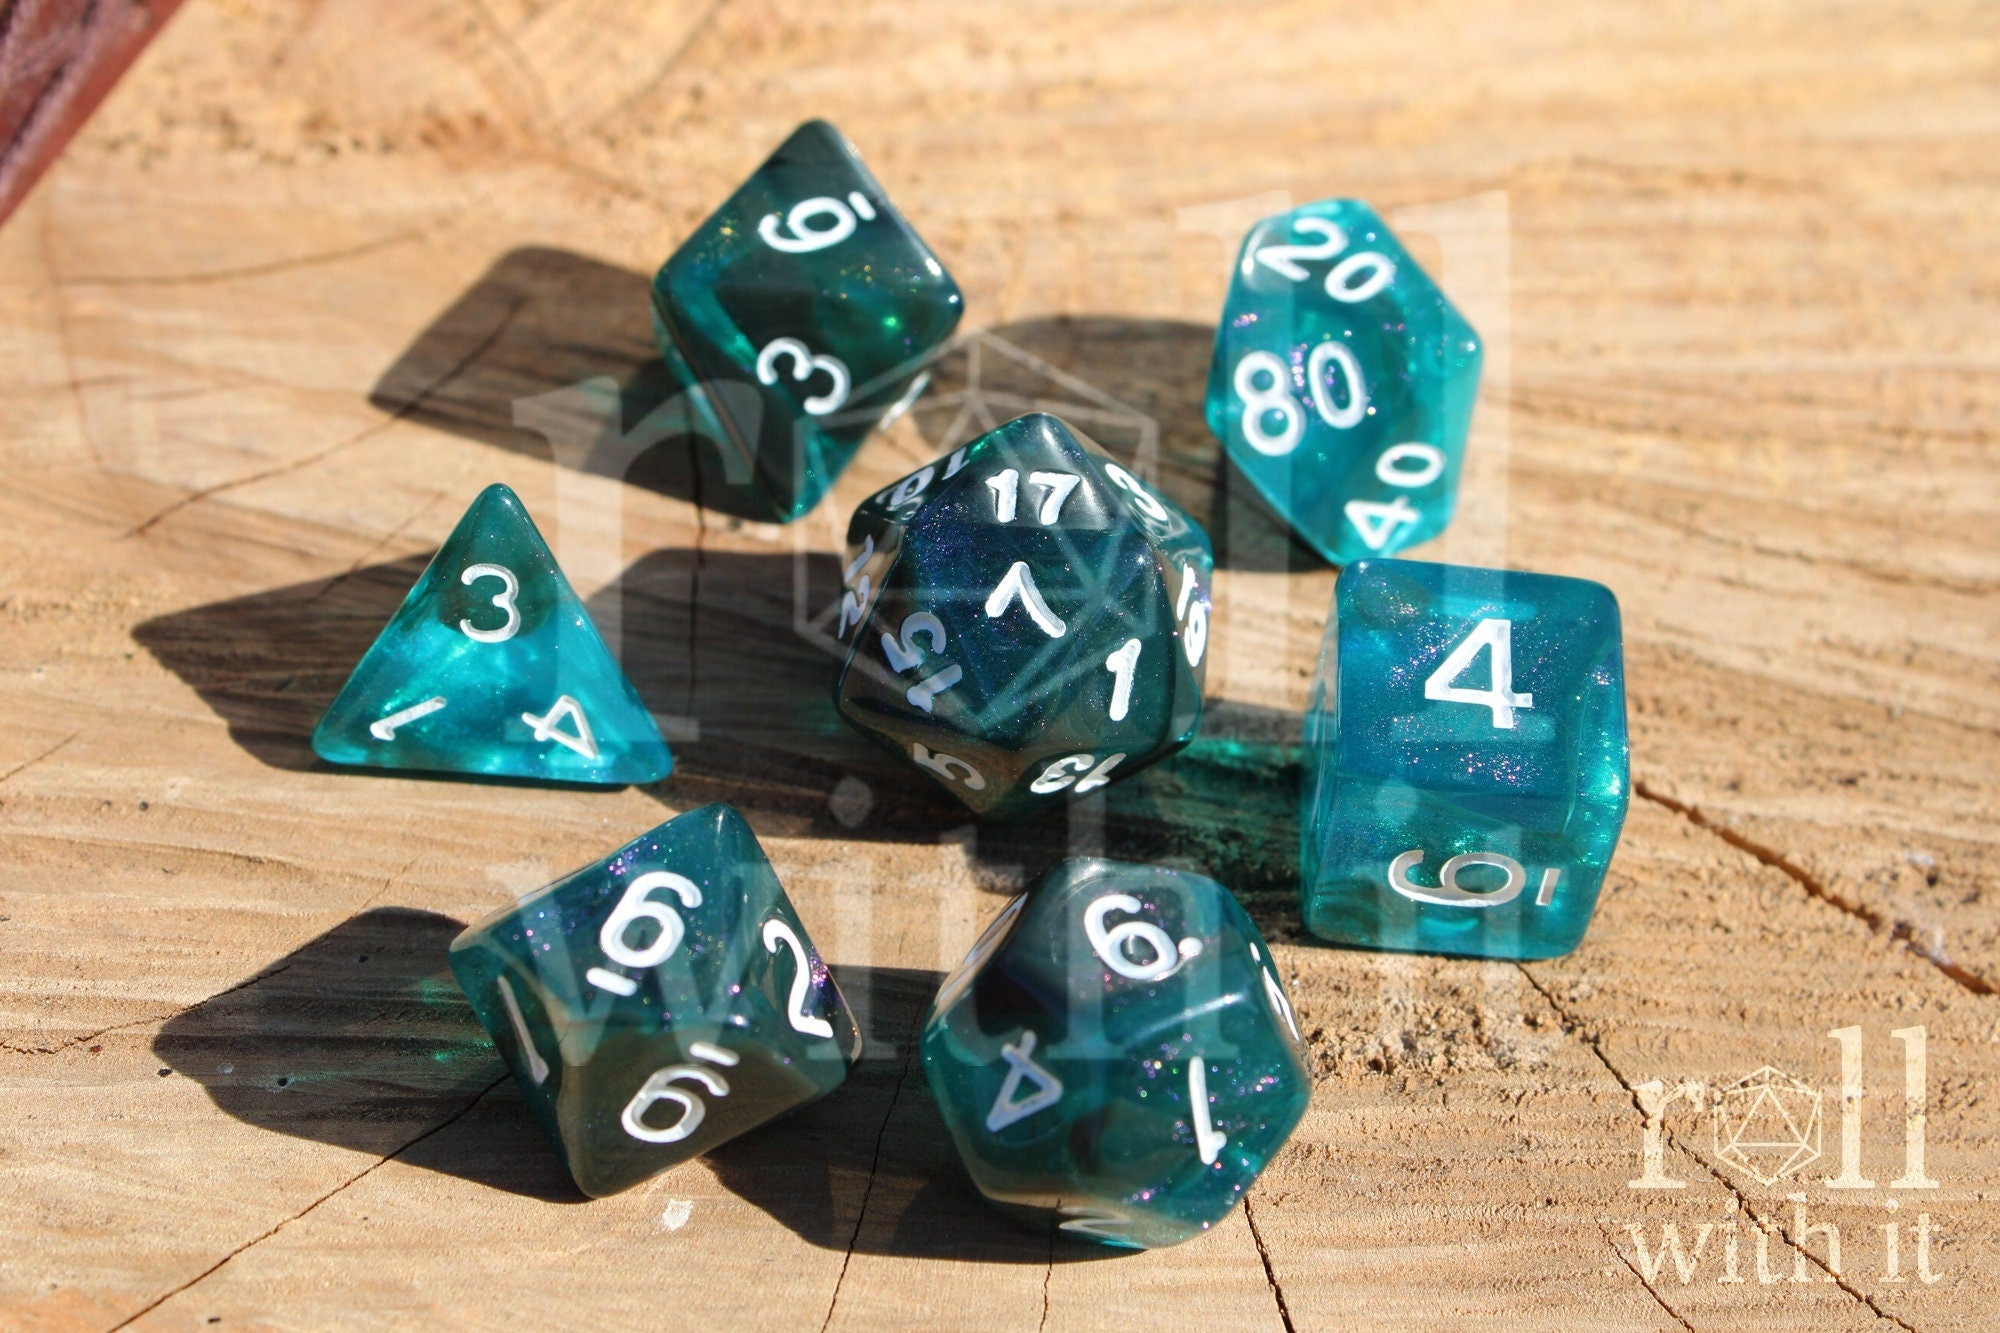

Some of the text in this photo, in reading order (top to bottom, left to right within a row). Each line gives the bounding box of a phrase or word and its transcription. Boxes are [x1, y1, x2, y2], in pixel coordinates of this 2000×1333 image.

[757, 337, 851, 416] 3
[1234, 341, 1367, 457] 80
[985, 468, 1081, 526] 17
[1104, 462, 1169, 522] 3
[1344, 442, 1447, 550] 40
[459, 563, 522, 643] 3
[985, 561, 1067, 639] 7
[880, 611, 963, 714] 15
[1105, 638, 1142, 722] 1
[1425, 618, 1533, 730] 4
[369, 696, 447, 742] 1
[521, 694, 600, 760] 4
[912, 742, 987, 791] 5
[1030, 753, 1127, 794] 13
[762, 918, 835, 1039] 2
[985, 1029, 1064, 1134] 4
[1188, 1055, 1228, 1166] 1
